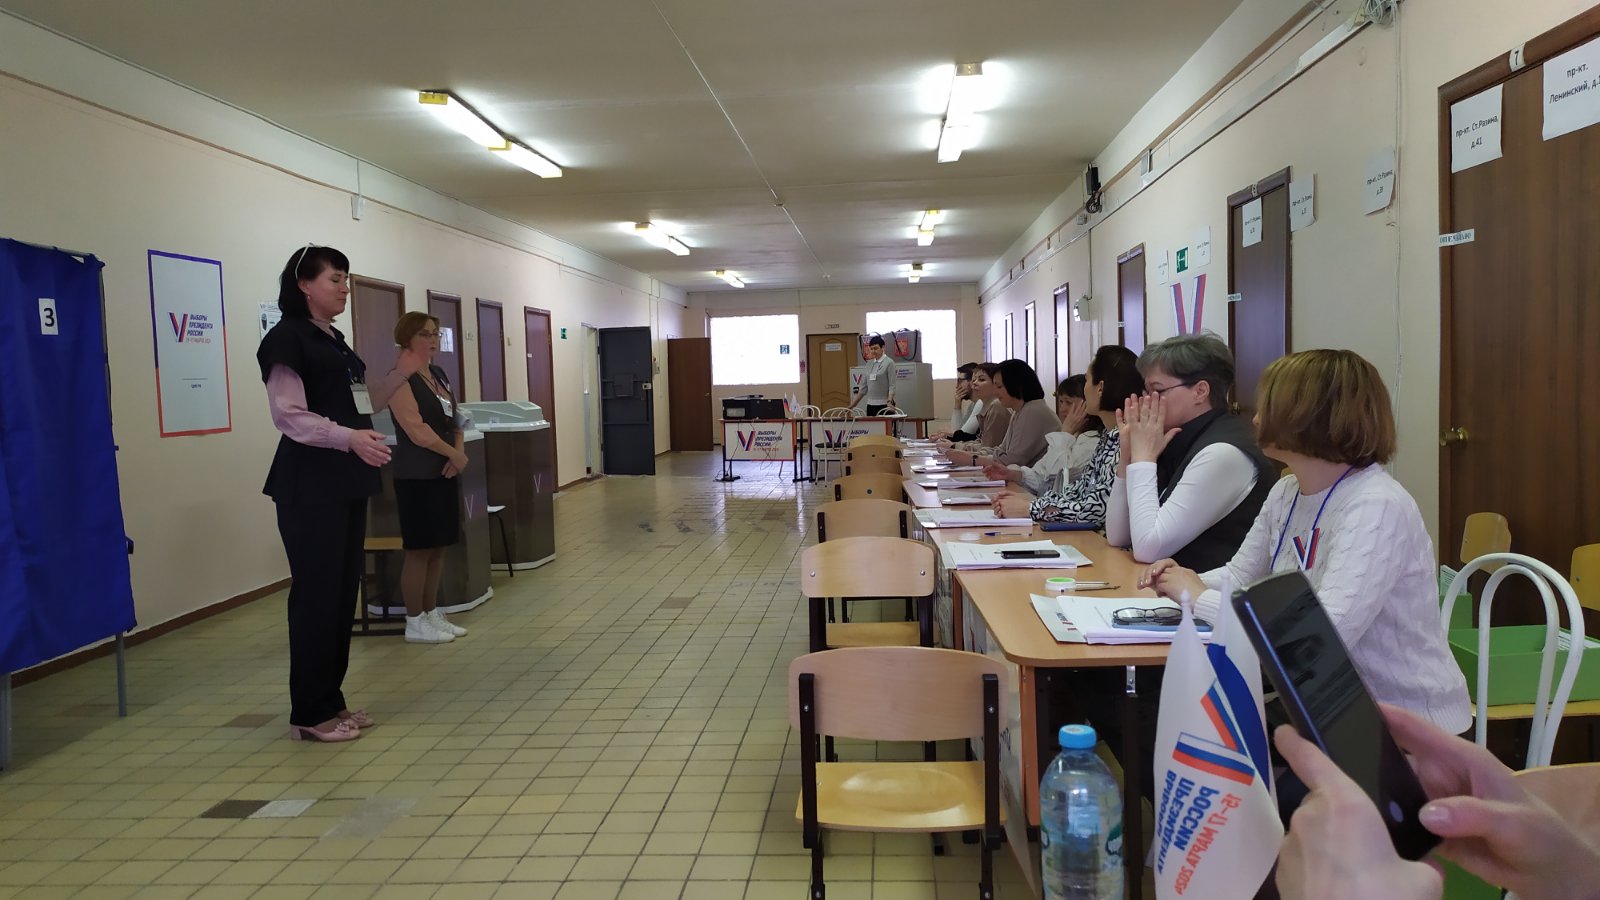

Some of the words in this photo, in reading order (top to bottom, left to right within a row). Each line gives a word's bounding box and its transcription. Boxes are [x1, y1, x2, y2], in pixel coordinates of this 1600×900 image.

[1514, 50, 1520, 66] 7
[1566, 63, 1589, 78] пр-кт.
[1549, 79, 1590, 104] Ленинский,
[44, 307, 55, 328] 3
